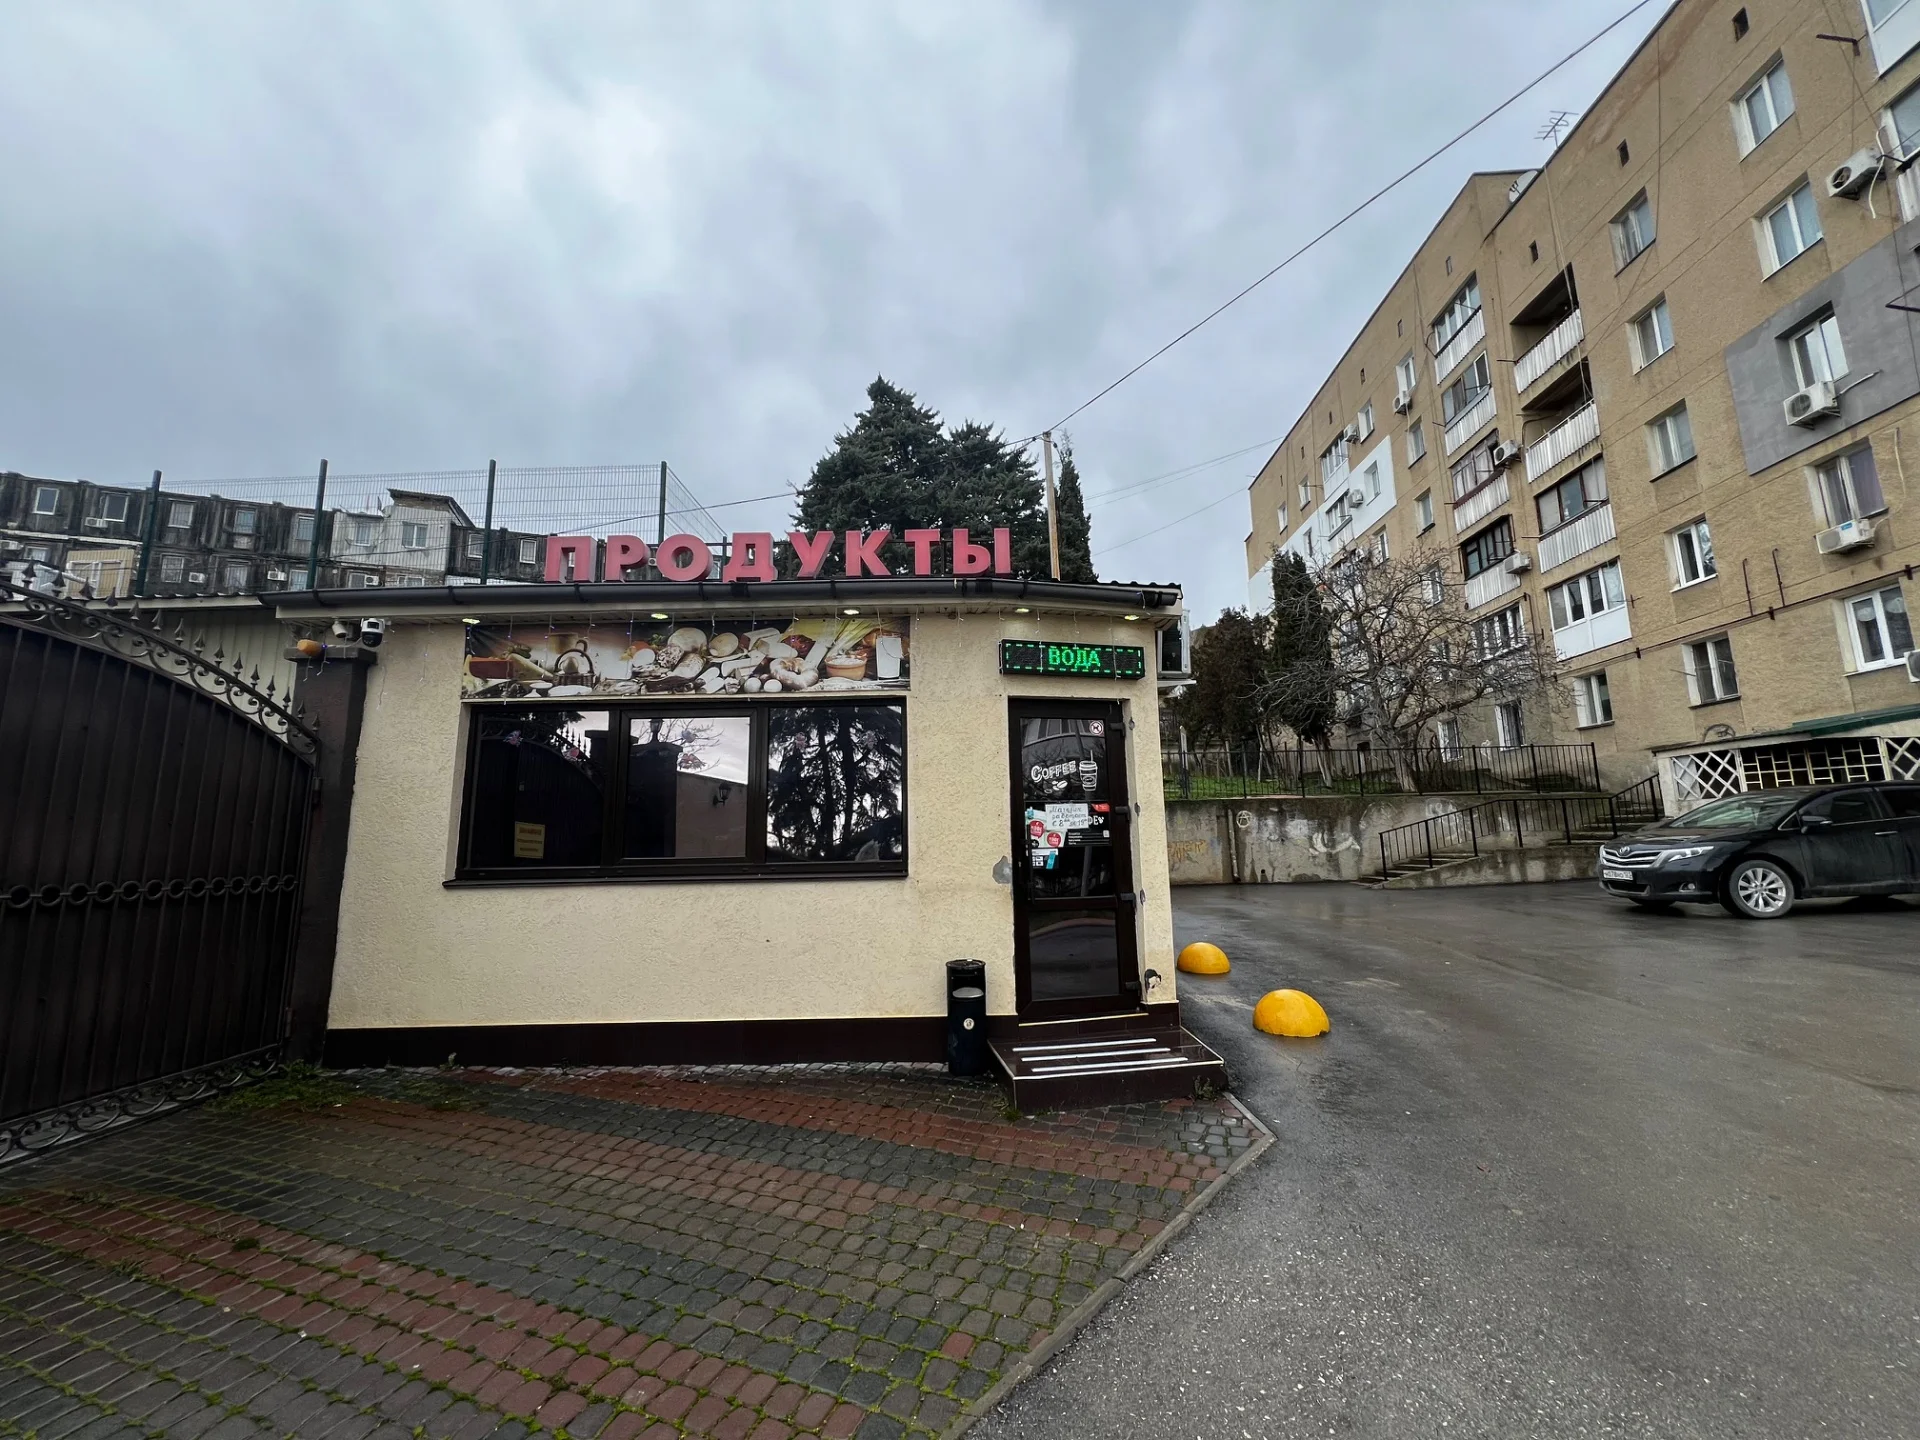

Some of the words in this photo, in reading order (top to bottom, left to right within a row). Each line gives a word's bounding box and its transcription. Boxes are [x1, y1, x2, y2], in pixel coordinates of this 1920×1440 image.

[544, 527, 1014, 583] ПРОДУКТЫ
[1048, 648, 1101, 669] ВОДА
[1031, 760, 1077, 783] COFFEE
